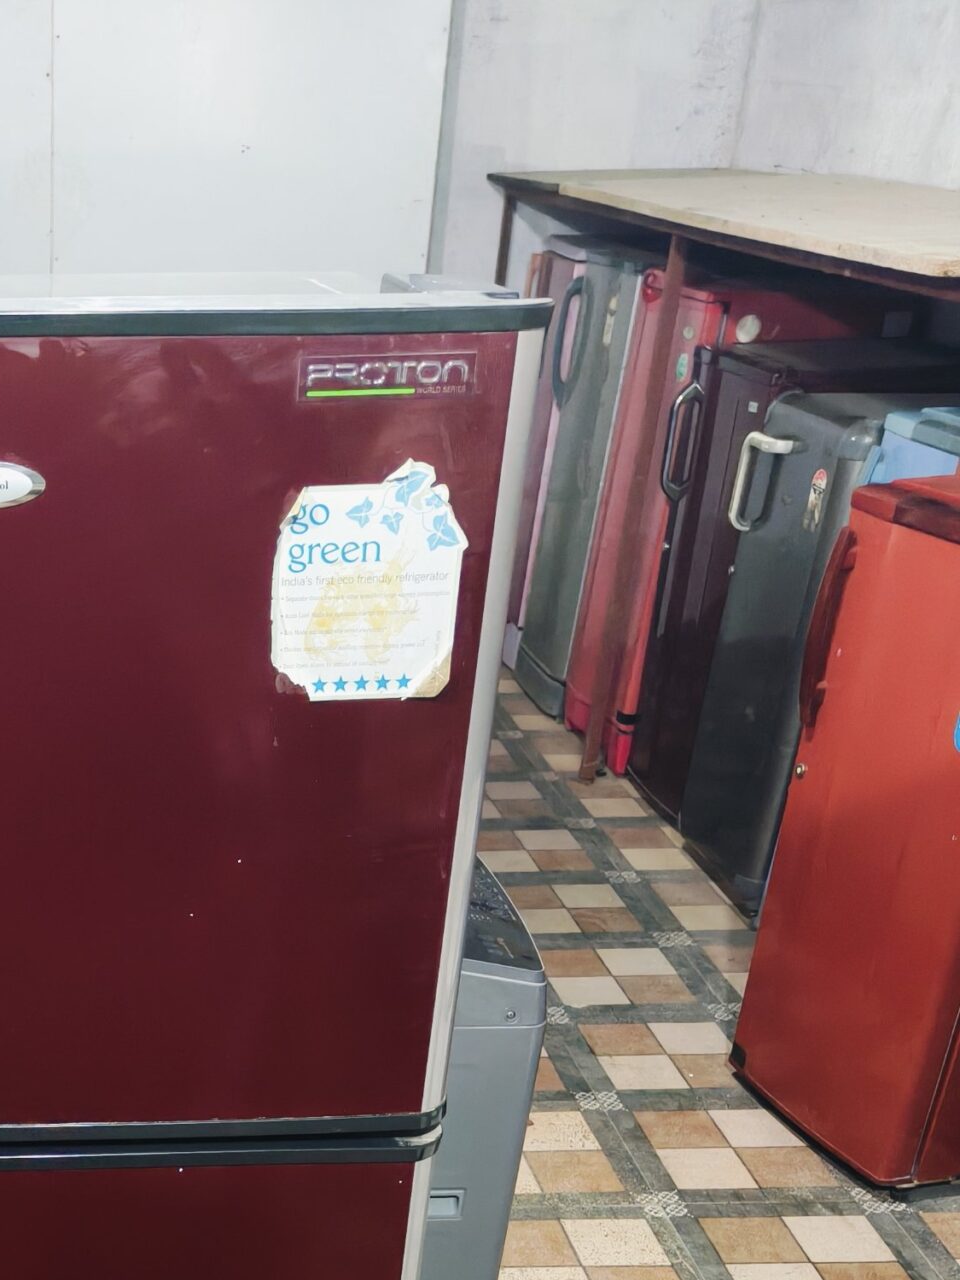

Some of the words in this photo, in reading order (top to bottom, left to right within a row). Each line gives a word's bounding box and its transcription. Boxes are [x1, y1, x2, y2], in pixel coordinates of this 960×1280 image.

[290, 503, 330, 535] go
[288, 540, 382, 573] green
[281, 576, 313, 587] India's
[316, 575, 334, 586] first
[337, 576, 354, 585] eco
[357, 574, 392, 586] friendly
[395, 571, 449, 585] refrigerator
